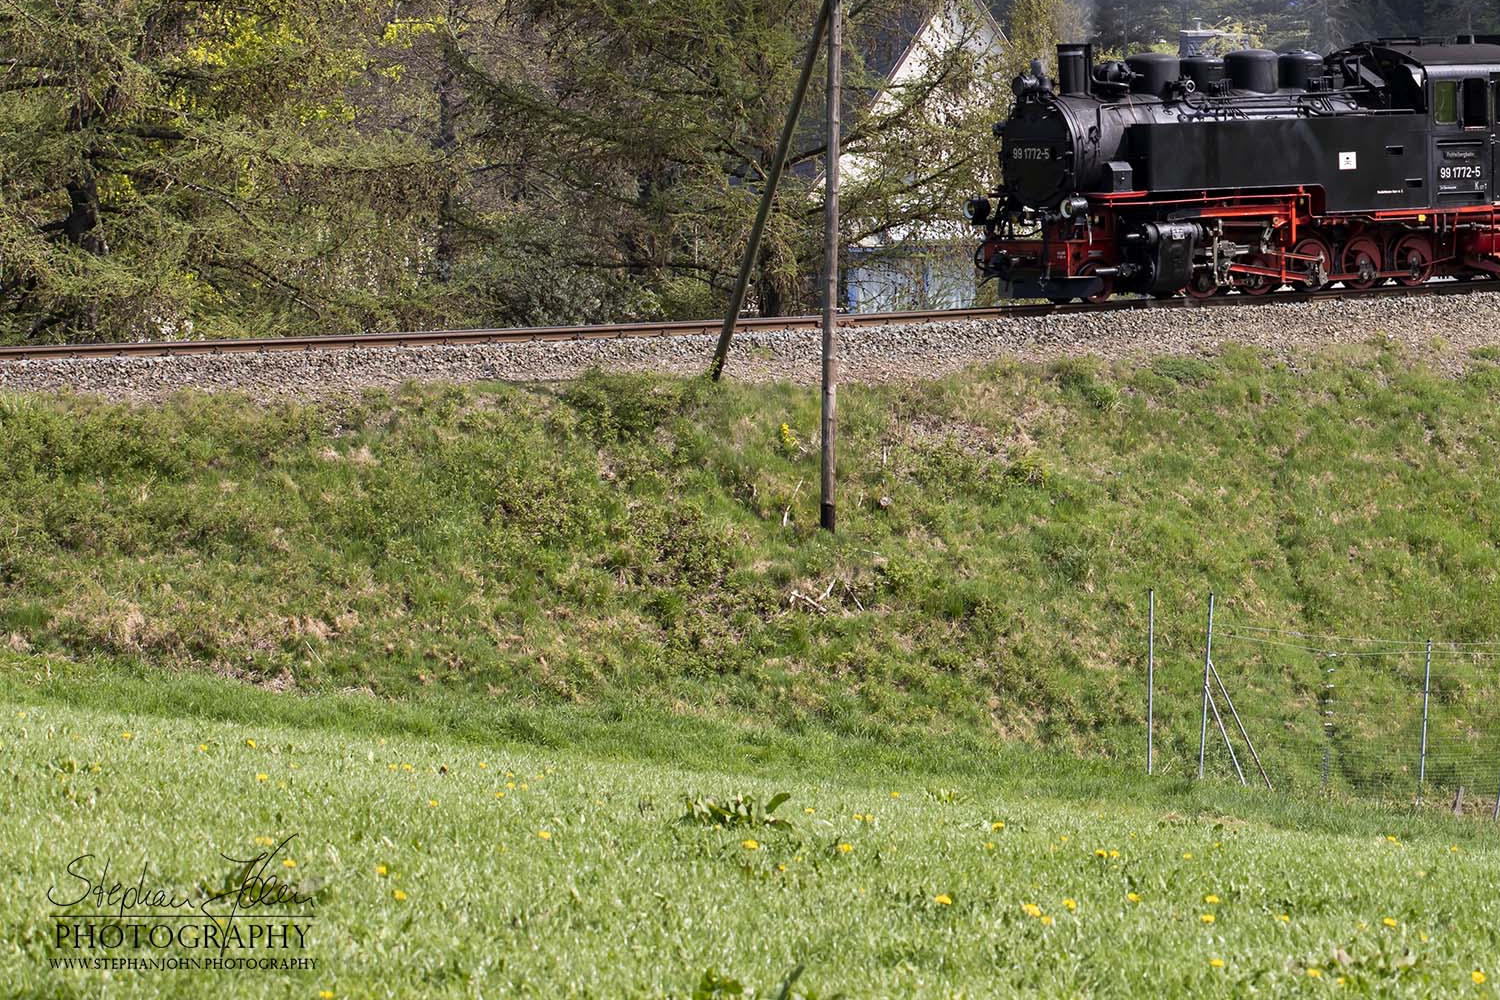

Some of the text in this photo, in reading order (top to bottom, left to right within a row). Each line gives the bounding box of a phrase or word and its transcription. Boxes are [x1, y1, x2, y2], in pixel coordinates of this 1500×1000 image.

[1013, 147, 1050, 160] 99 1772-5
[1440, 166, 1481, 179] 99 1772-5
